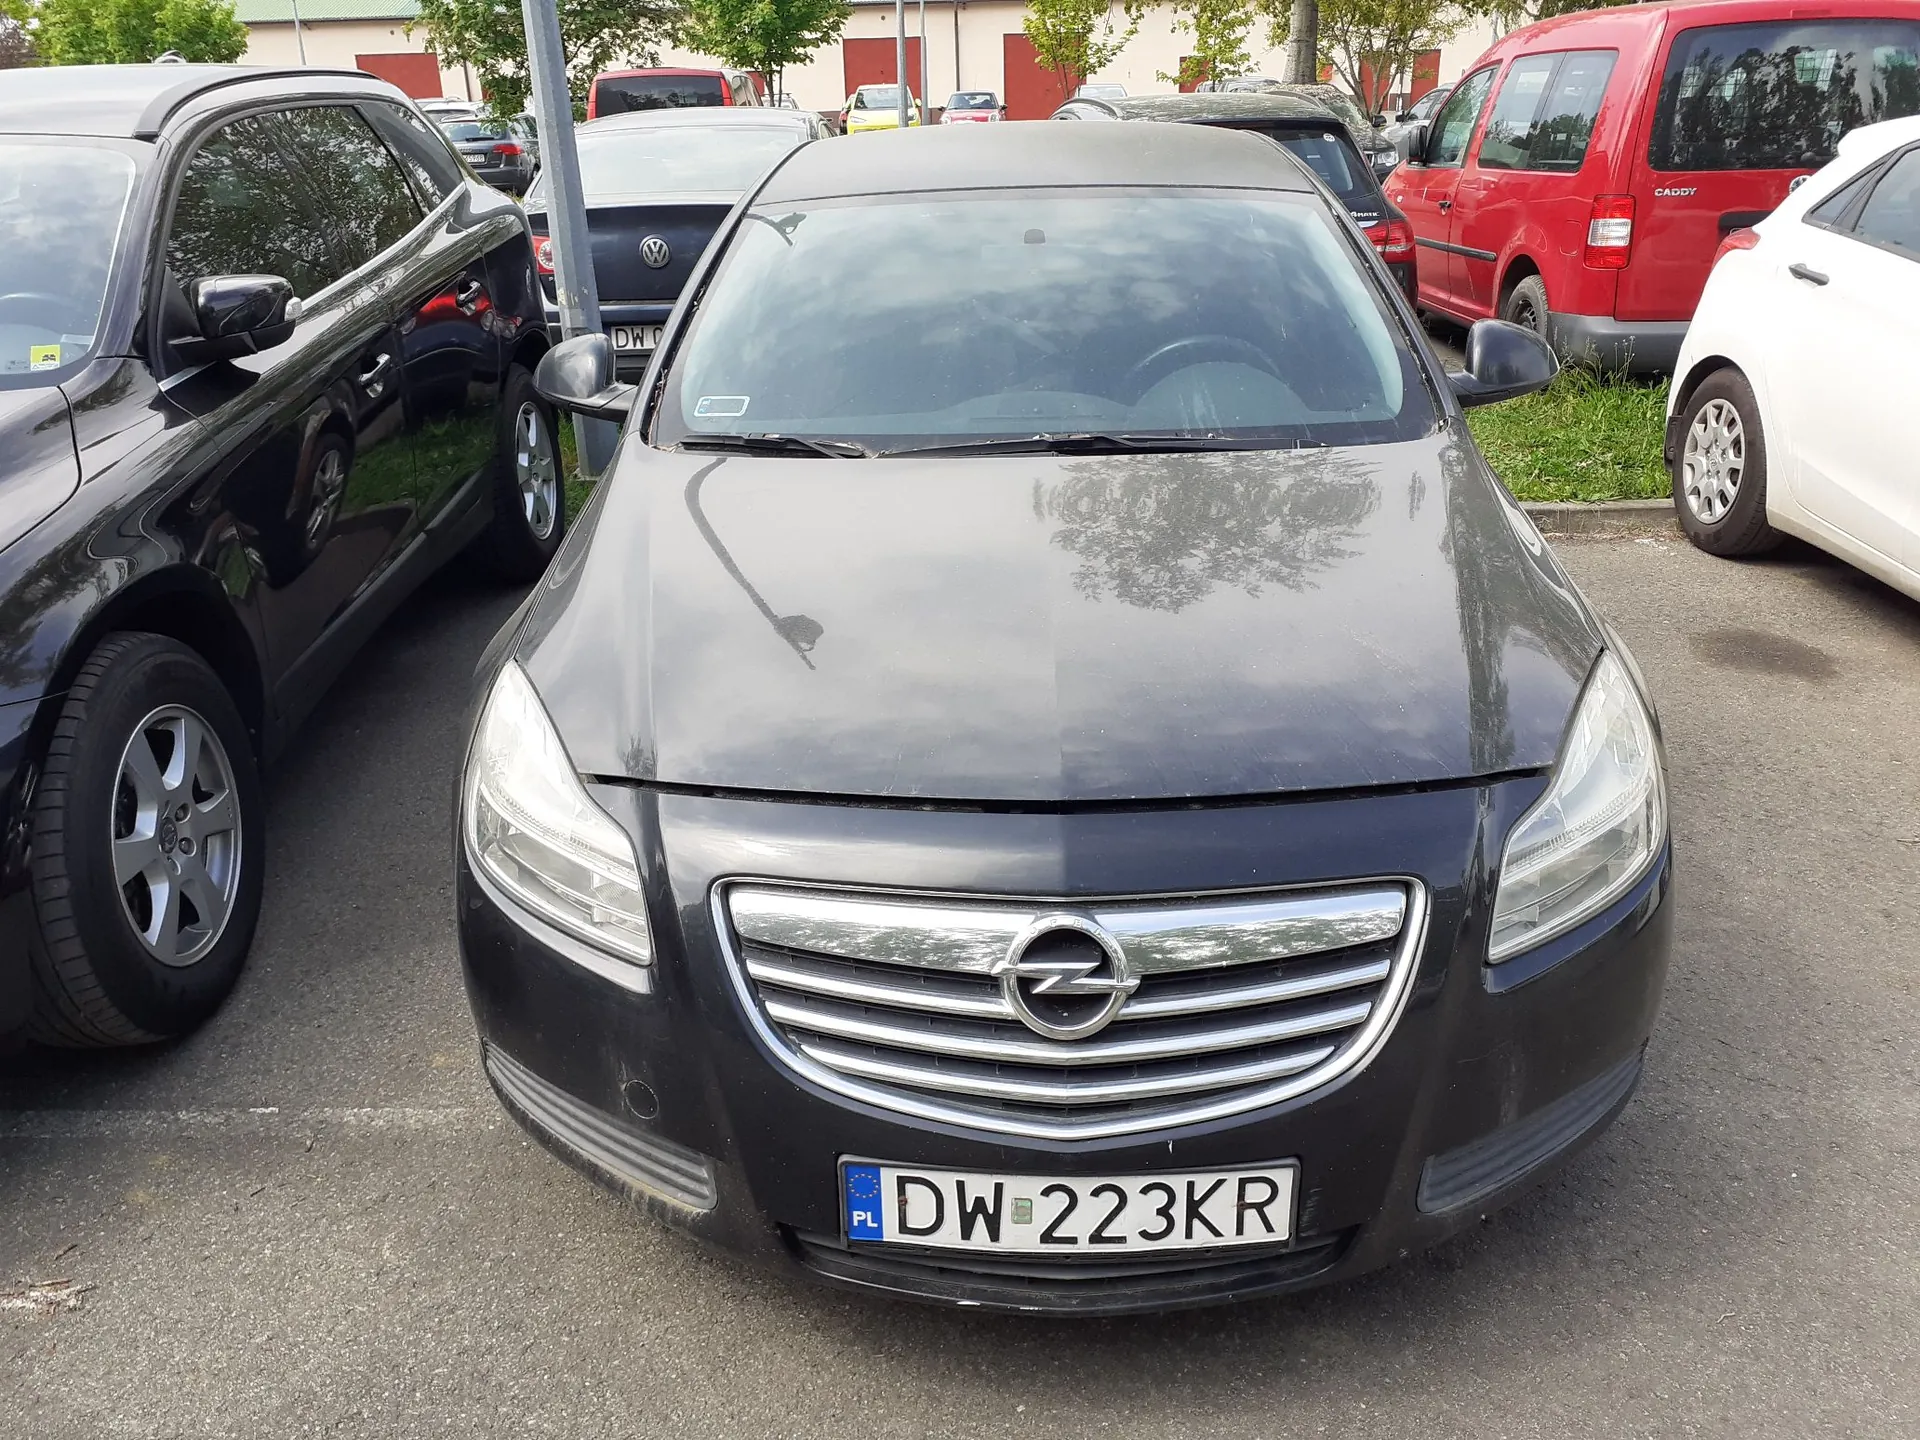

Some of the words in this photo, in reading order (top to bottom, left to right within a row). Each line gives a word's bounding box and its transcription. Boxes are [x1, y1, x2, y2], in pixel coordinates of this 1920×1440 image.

[1654, 187, 1698, 197] CADDY
[640, 235, 670, 268] VW
[615, 327, 644, 348] DW
[1029, 918, 1105, 941] OPEL
[852, 1210, 879, 1228] PL
[896, 1174, 1004, 1243] DW
[1039, 1175, 1280, 1245] 223KR
